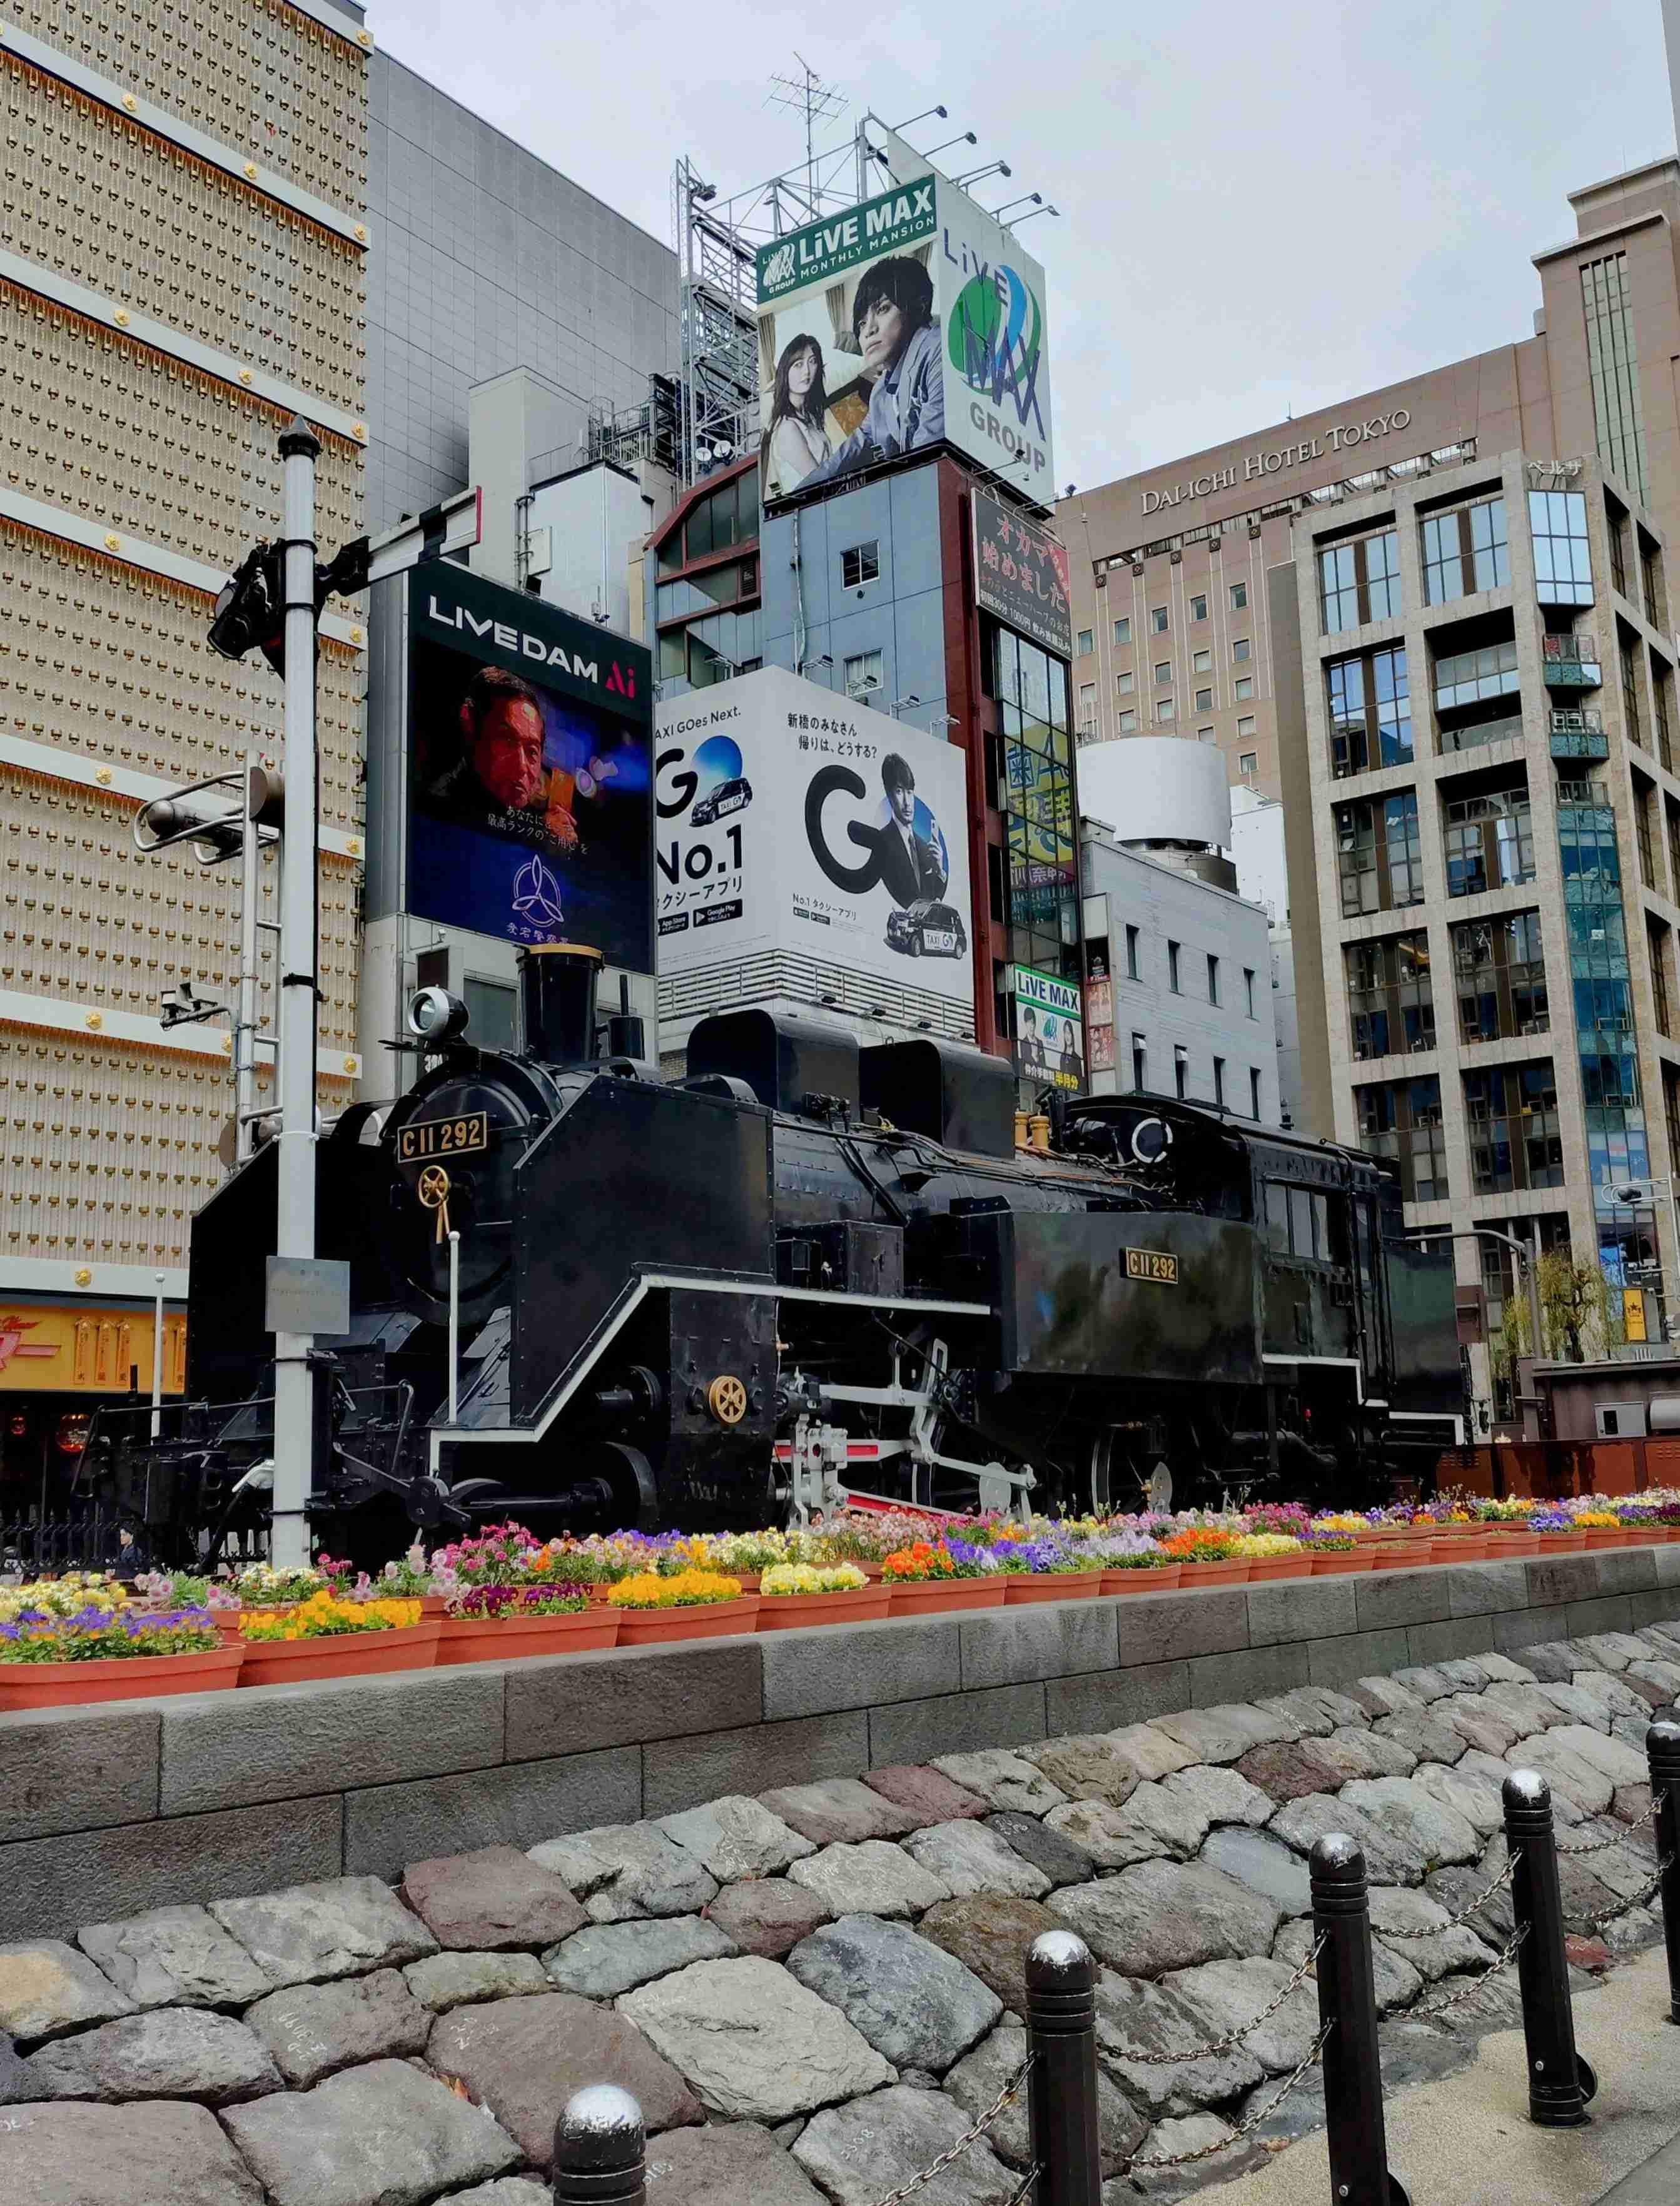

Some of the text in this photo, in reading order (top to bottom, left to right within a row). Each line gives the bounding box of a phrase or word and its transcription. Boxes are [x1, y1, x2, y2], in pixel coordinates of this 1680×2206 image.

[866, 185, 933, 237] MAX
[800, 216, 934, 279] MONTHLY MANSION
[769, 278, 796, 294] GROUP
[963, 299, 1046, 442] MAX
[969, 401, 1046, 473] GROUP
[1140, 409, 1411, 516] DAI-ICHI HOTEL TOKYO
[982, 535, 1066, 614] 始めました
[429, 595, 599, 684] LIVEDAM
[655, 706, 741, 739] AXI GOes Next.
[787, 712, 857, 737] 新橋のみなさん
[792, 893, 810, 906] No.1
[1049, 983, 1078, 1011] MAX
[440, 1118, 481, 1150] 292
[1152, 1256, 1175, 1279] 292
